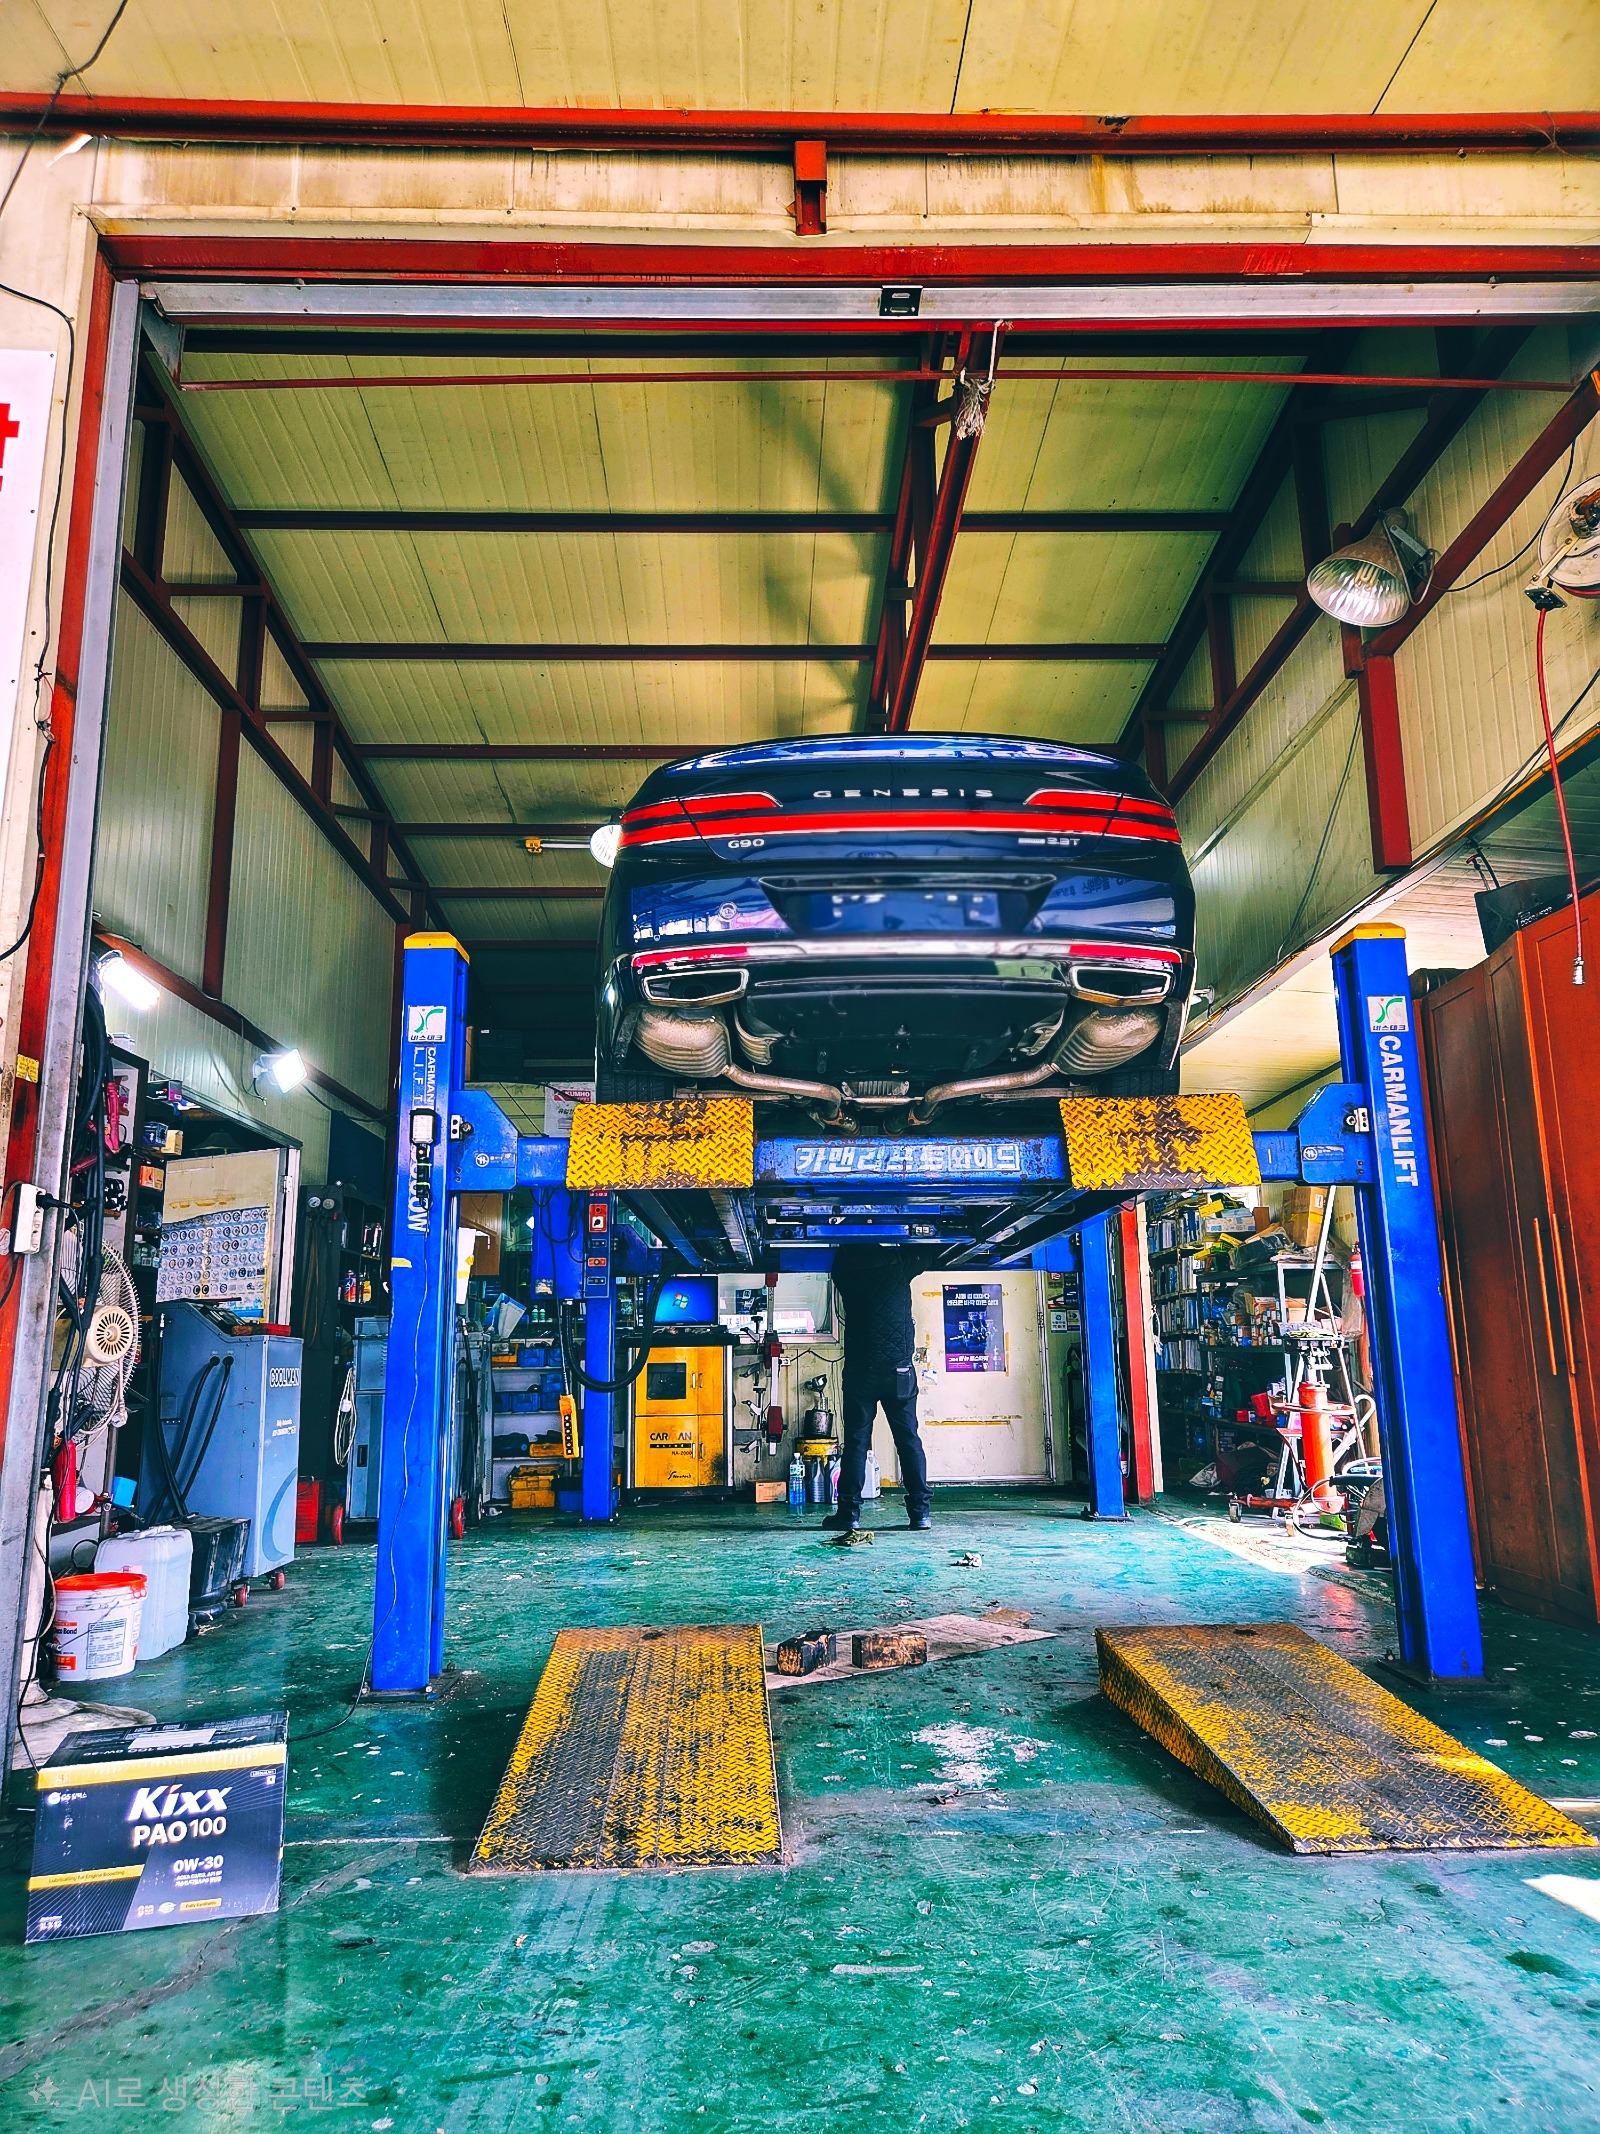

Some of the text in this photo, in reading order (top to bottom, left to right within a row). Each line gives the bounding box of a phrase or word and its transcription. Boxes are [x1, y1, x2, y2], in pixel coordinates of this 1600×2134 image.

[812, 788, 993, 798] GENESIS
[727, 838, 765, 849] G90
[426, 1047, 437, 1105] CARMAN
[1379, 1035, 1419, 1187] CARMANLIFT
[951, 1145, 1017, 1170] 와이드
[269, 1367, 300, 1388] COOLMAN
[650, 1432, 691, 1440] CARAN
[127, 1784, 233, 1821] Kixx
[132, 1816, 227, 1848] PAO 100
[172, 1854, 224, 1874] 0W-30
[85, 1872, 102, 1881] Engine
